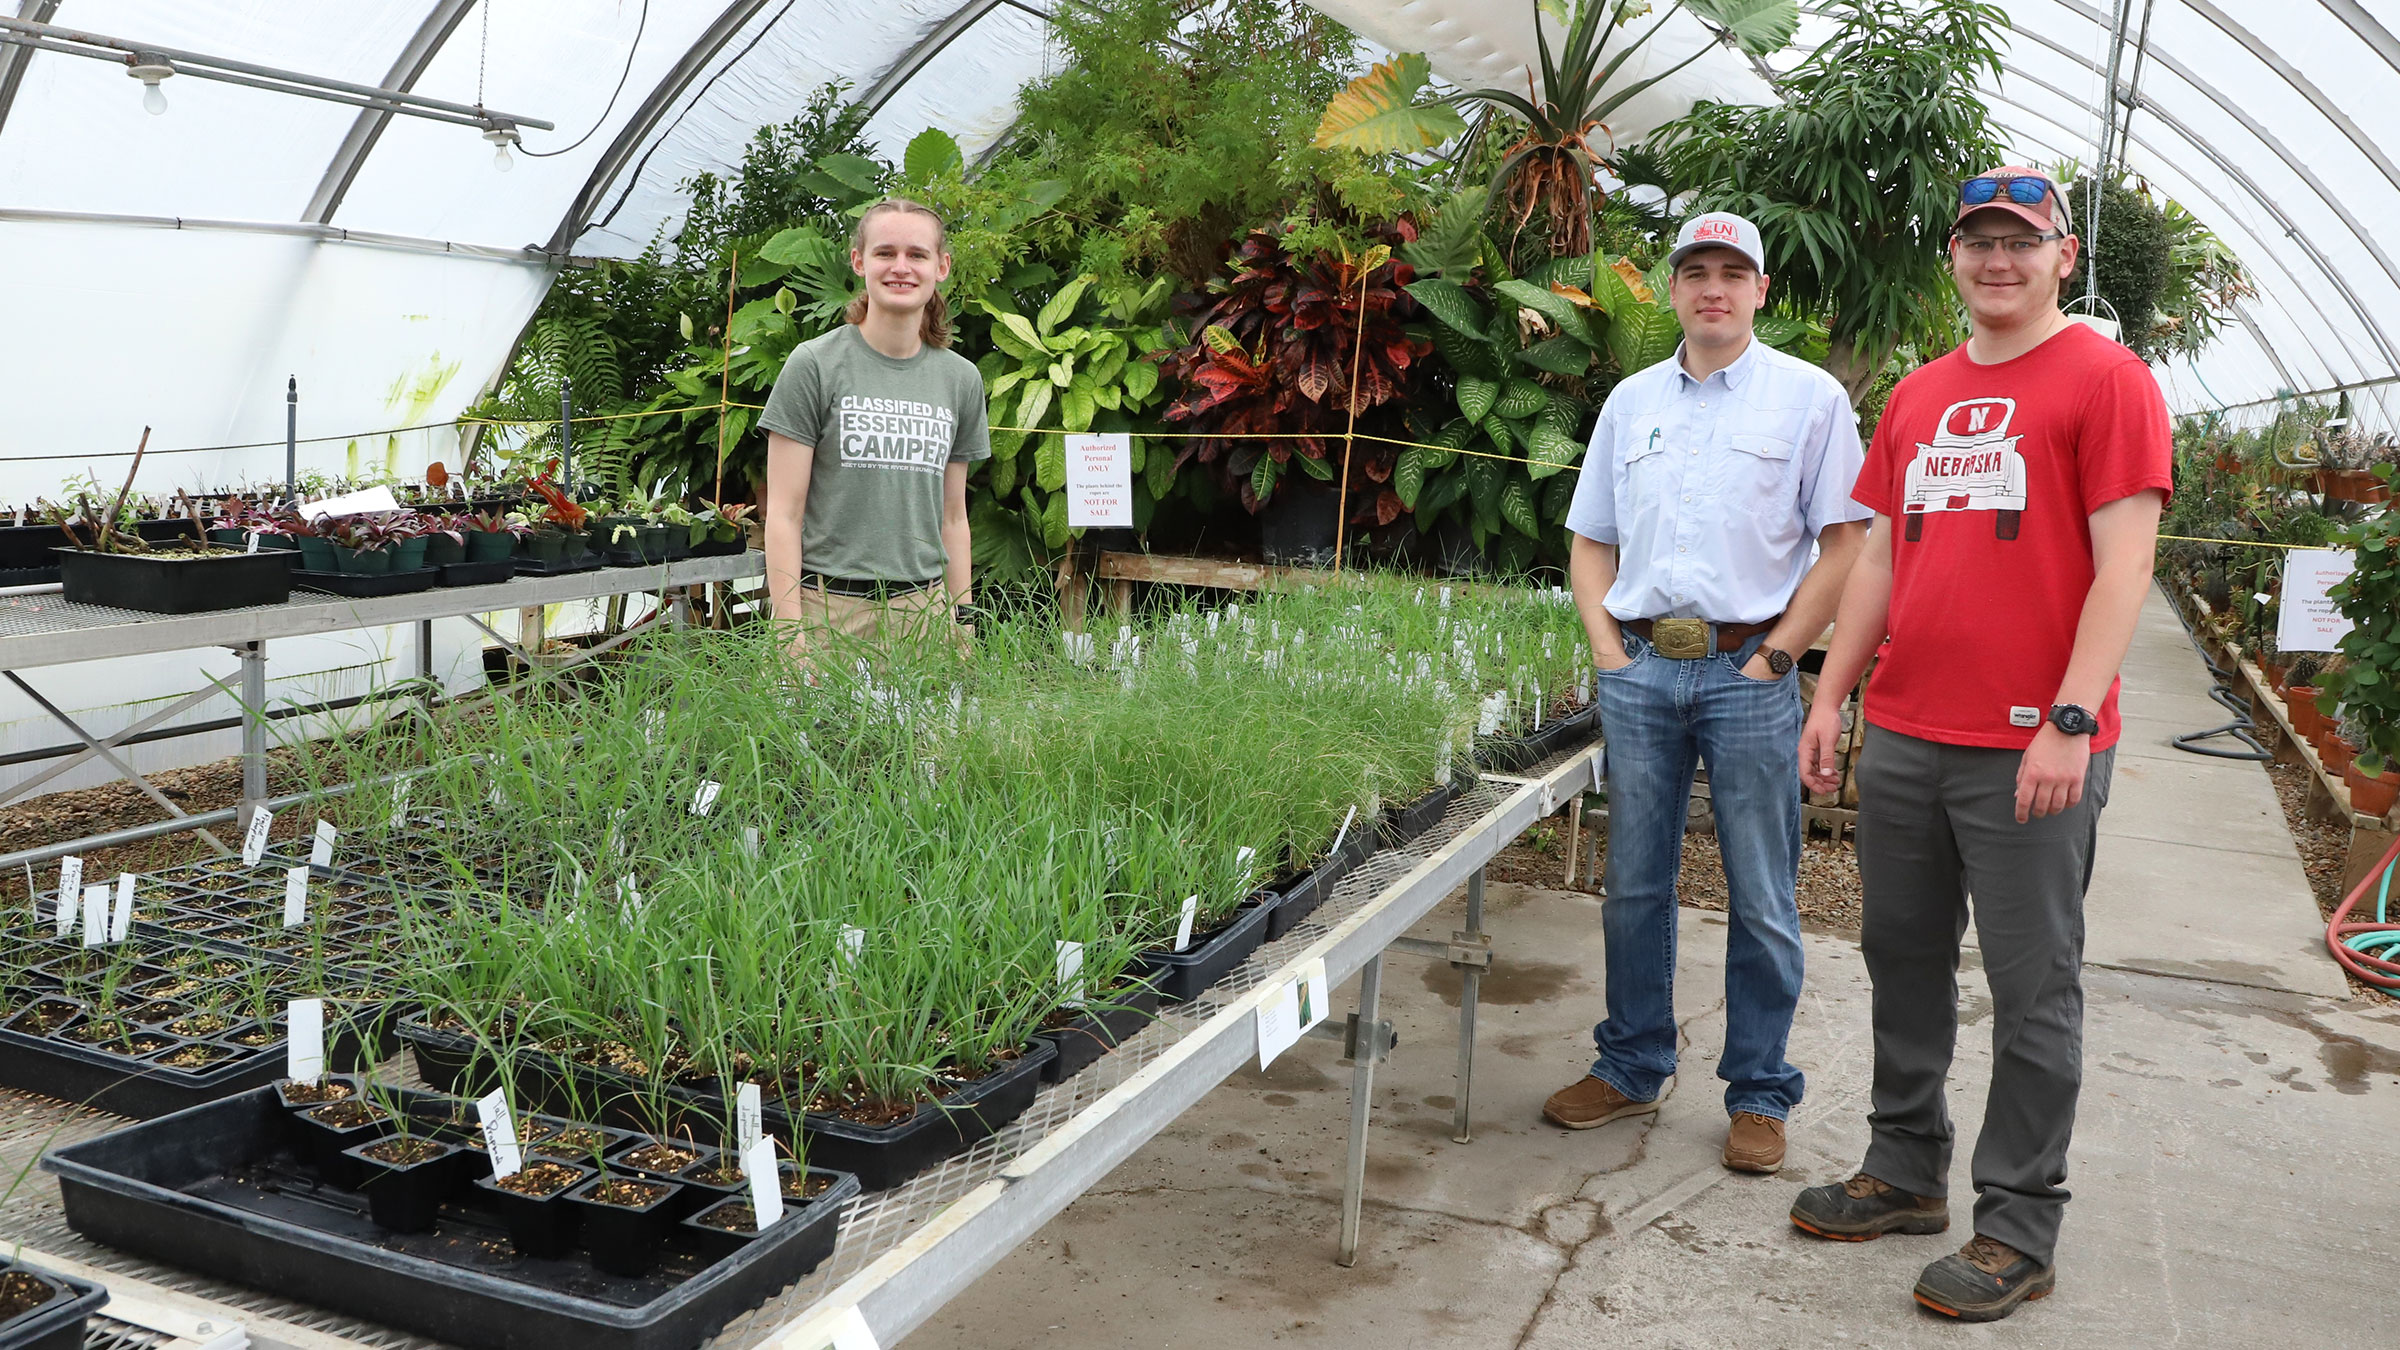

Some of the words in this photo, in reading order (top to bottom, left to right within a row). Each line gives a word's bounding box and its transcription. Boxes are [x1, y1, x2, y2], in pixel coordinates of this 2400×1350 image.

[841, 395, 932, 417] CLASSIFIED
[936, 406, 953, 422] AS
[1968, 406, 1990, 432] N
[843, 413, 949, 442] ESSENTIAL
[842, 433, 948, 466] CAMPER
[1925, 451, 2002, 477] NEBRASKA
[493, 1096, 507, 1121] Tall
